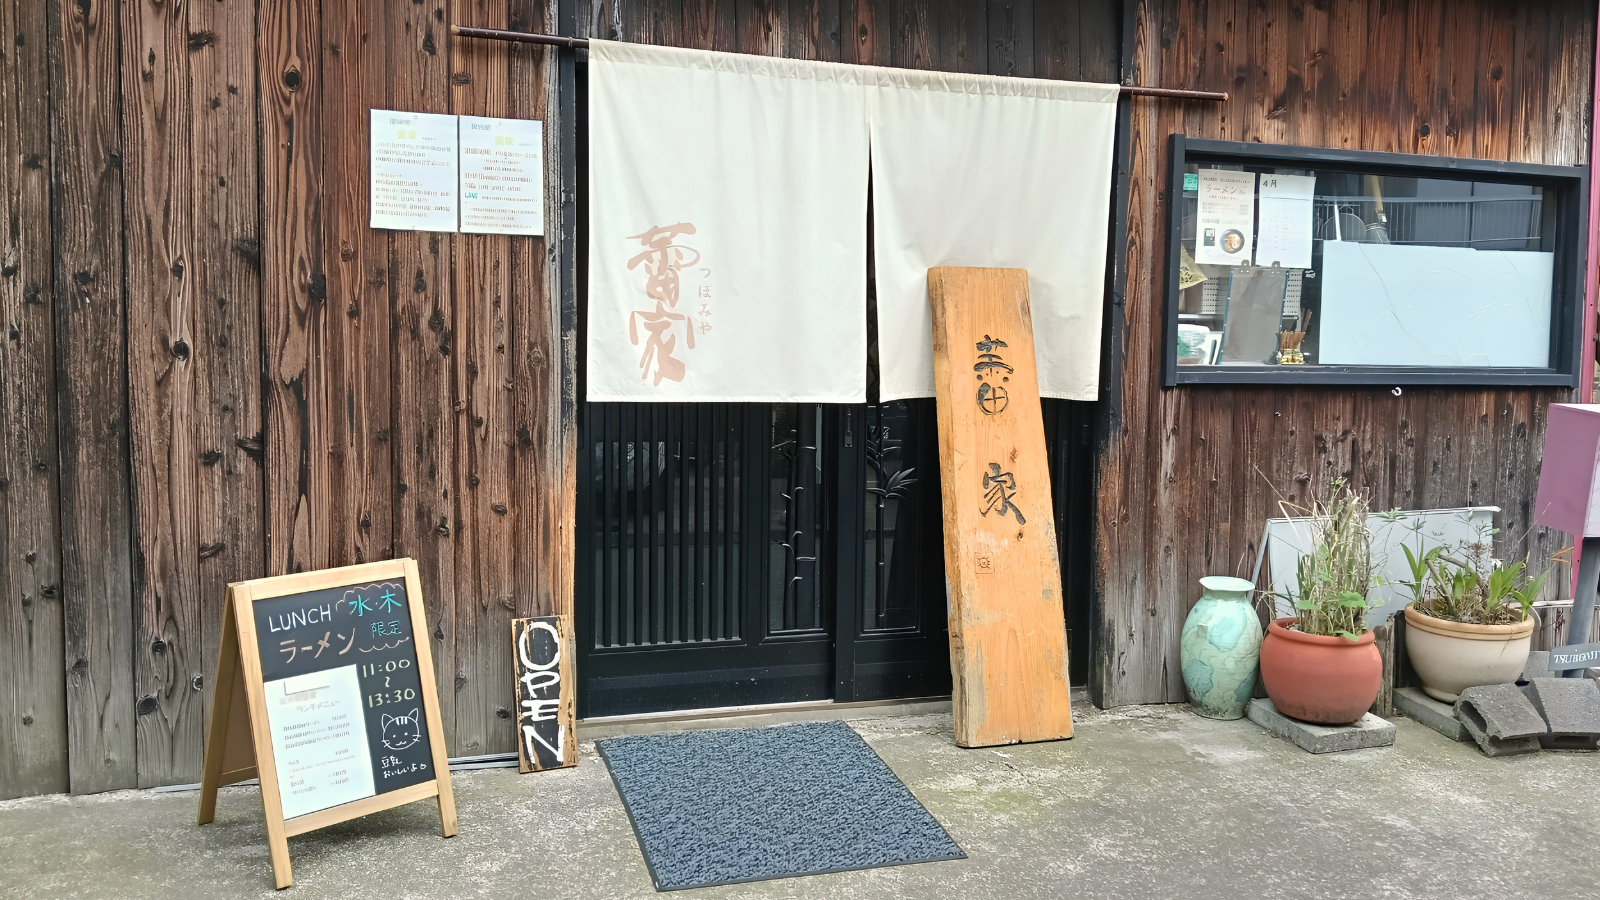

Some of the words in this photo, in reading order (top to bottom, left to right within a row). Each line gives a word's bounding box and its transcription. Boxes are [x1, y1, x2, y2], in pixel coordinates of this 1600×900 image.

[1262, 179, 1277, 188] 4月
[268, 603, 332, 633] LUNCH
[370, 619, 402, 639] 限定
[279, 627, 356, 664] ラーメン
[1553, 650, 1600, 664] TSUBOMI
[362, 659, 411, 678] 11:00
[368, 688, 416, 708] 13:30
[518, 620, 565, 765] OPEN
